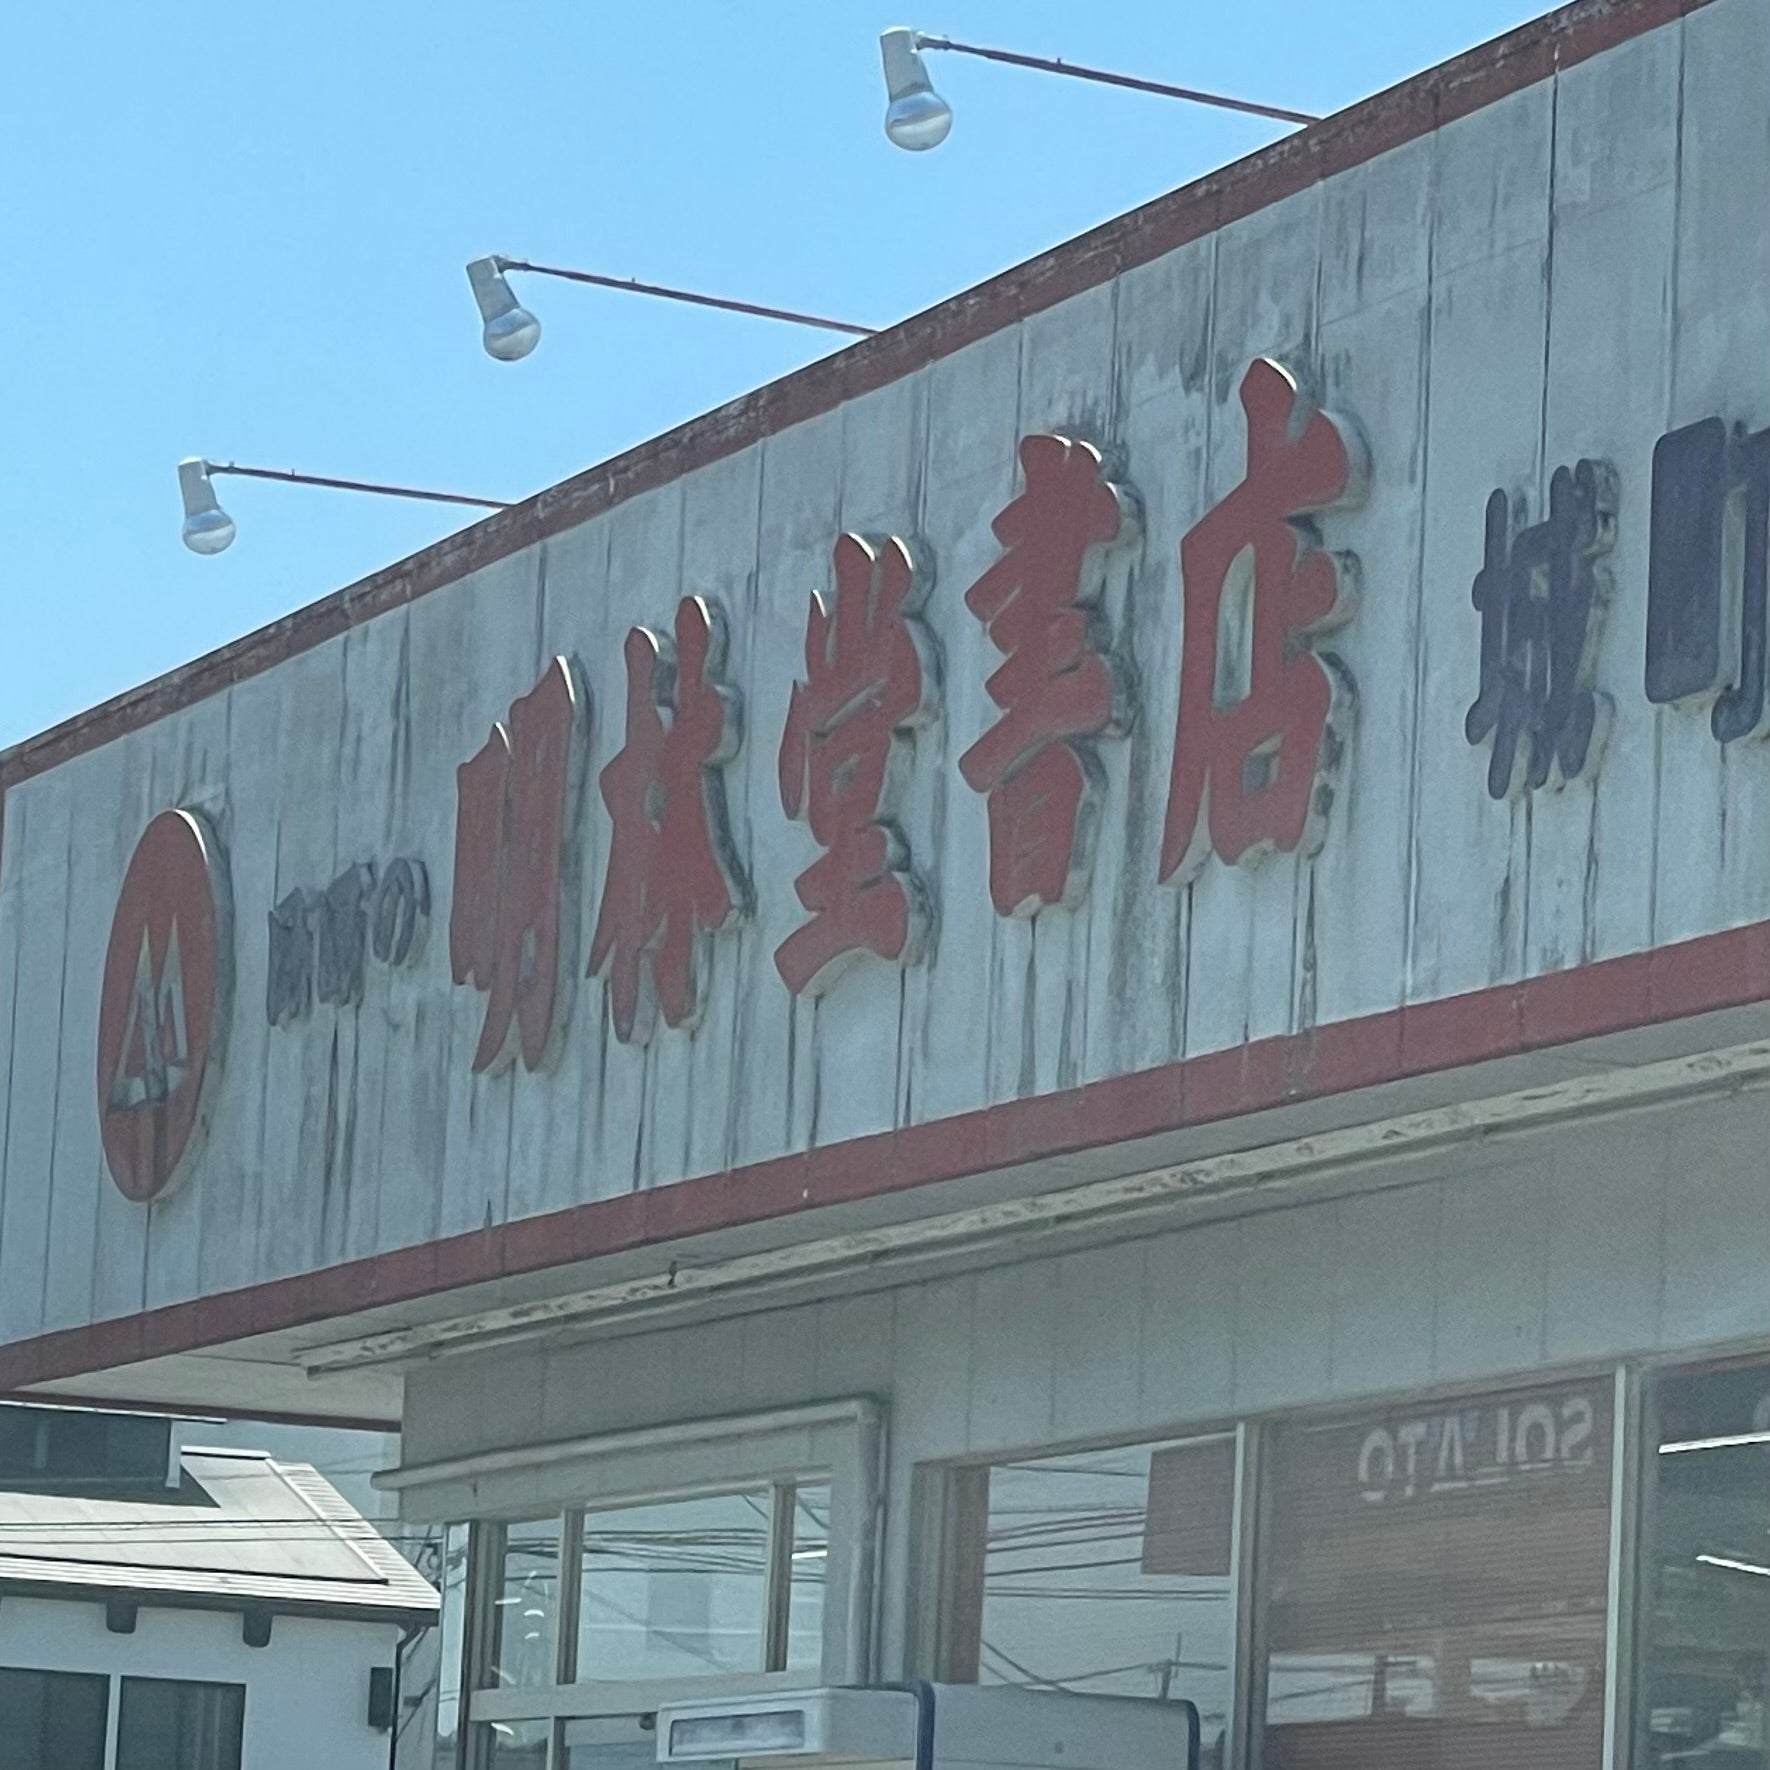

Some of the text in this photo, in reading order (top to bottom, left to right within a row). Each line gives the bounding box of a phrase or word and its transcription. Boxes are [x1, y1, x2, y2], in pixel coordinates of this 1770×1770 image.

[450, 357, 1352, 1073] 明林堂書店
